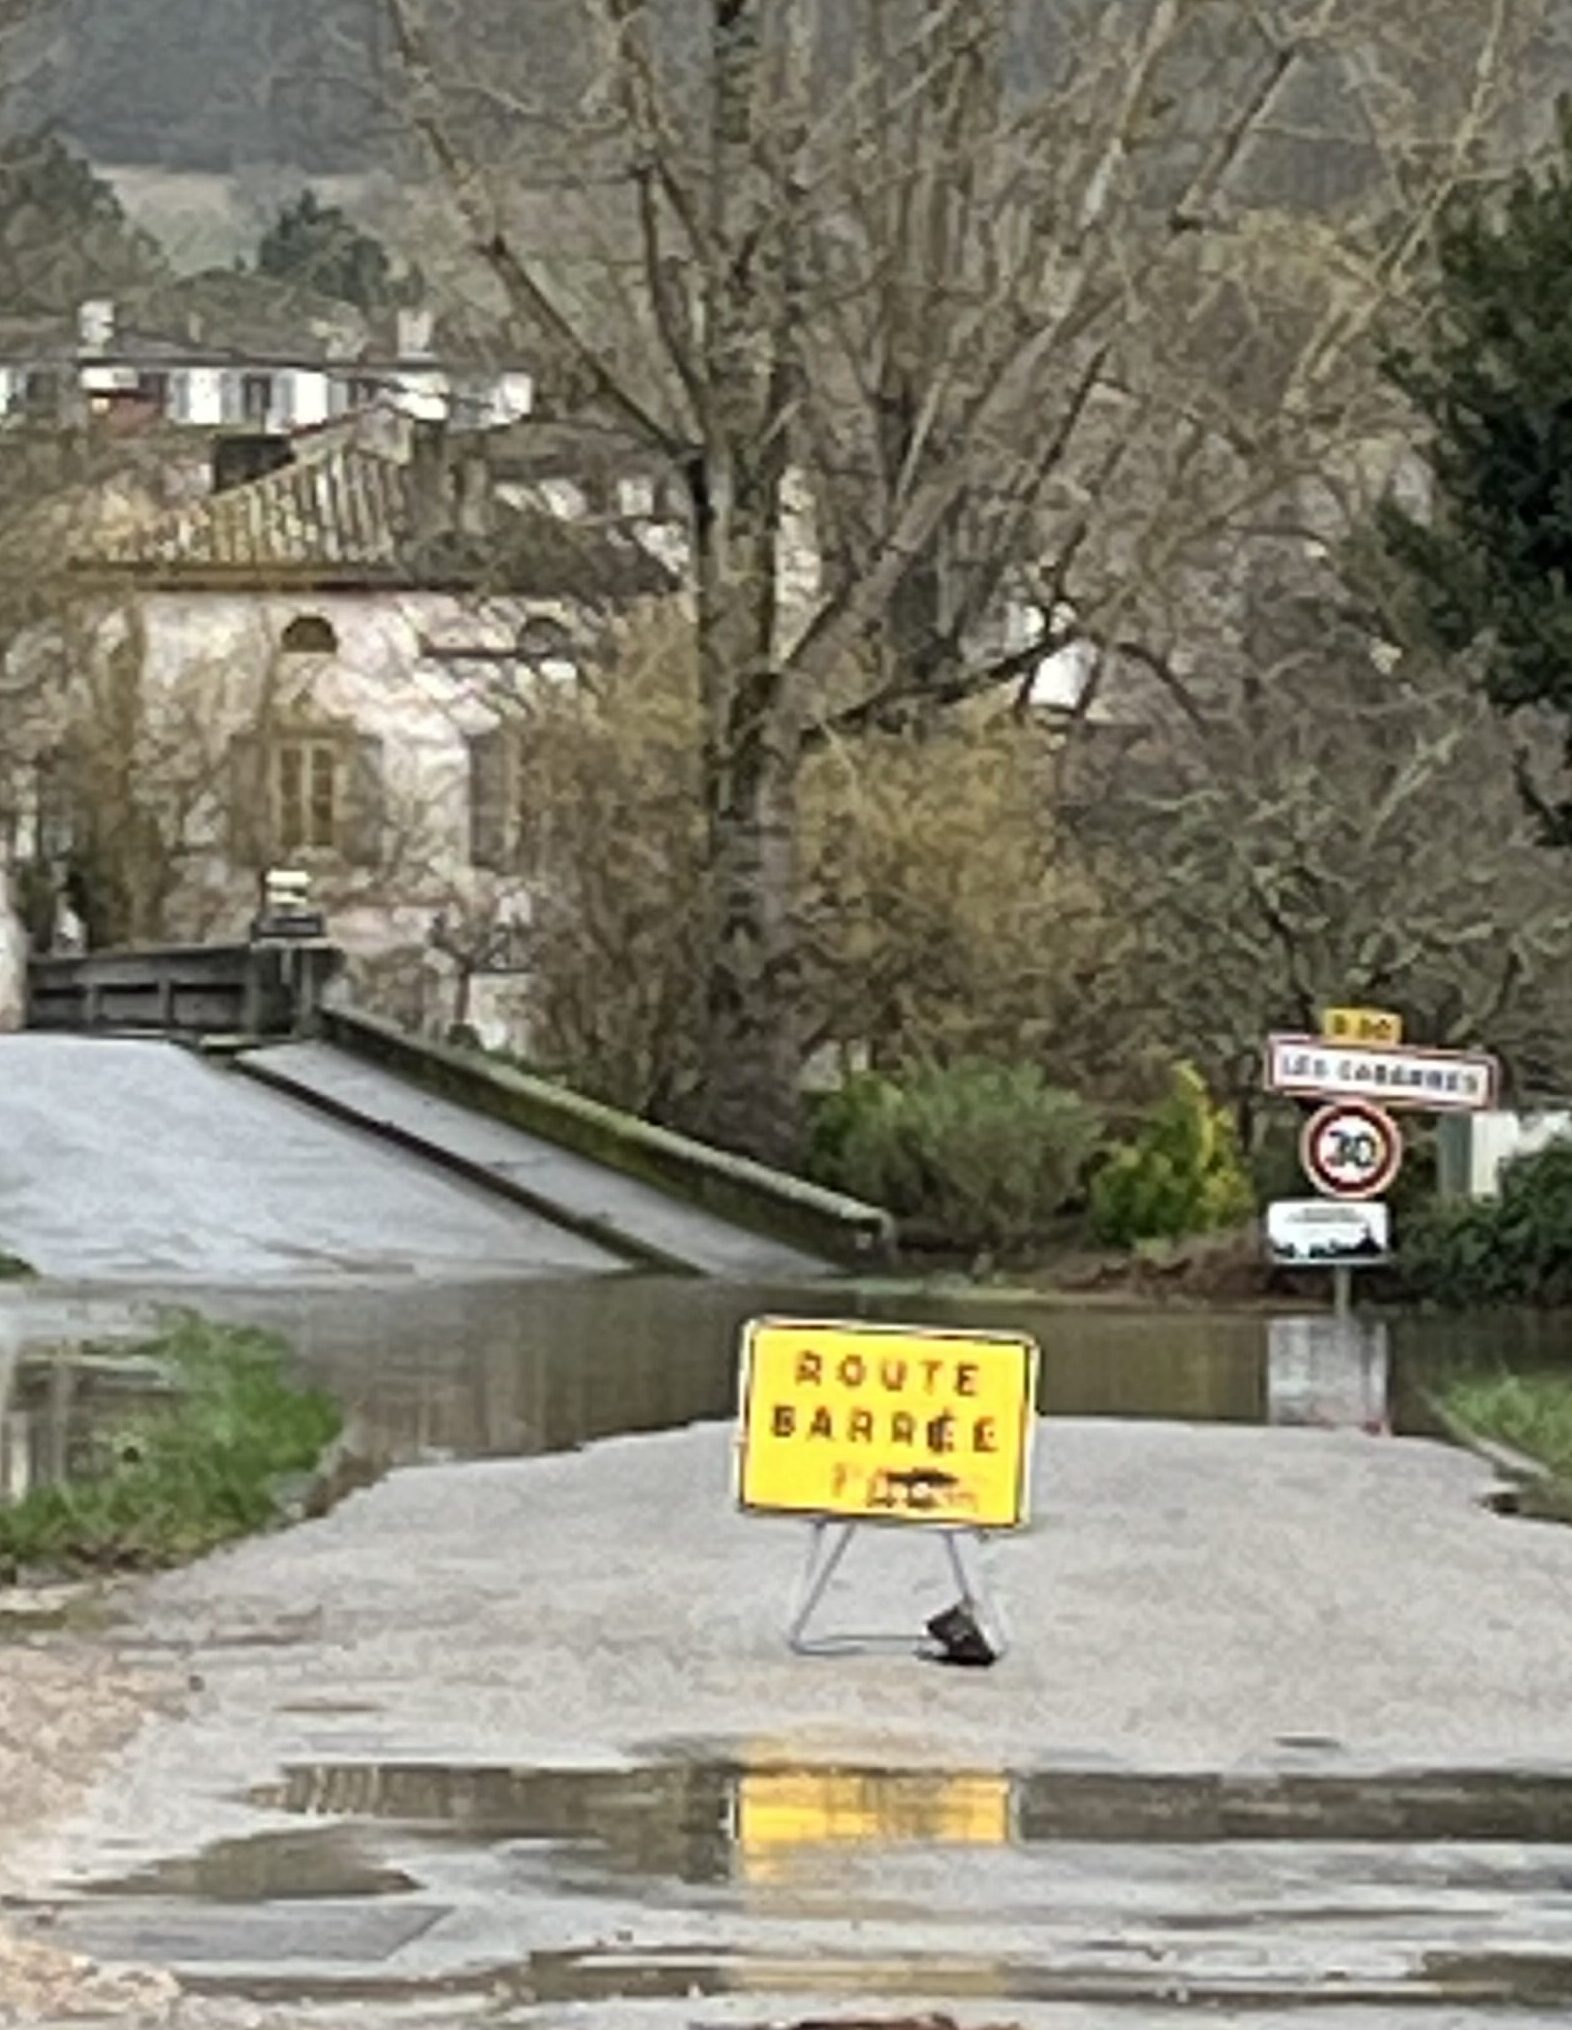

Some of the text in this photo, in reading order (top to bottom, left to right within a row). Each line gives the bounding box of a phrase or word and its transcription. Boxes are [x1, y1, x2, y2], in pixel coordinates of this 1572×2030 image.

[1282, 1053, 1328, 1077] LES
[1326, 1129, 1377, 1168] 30
[794, 1349, 980, 1397] ROUTE
[771, 1405, 999, 1454] BARRÉE
